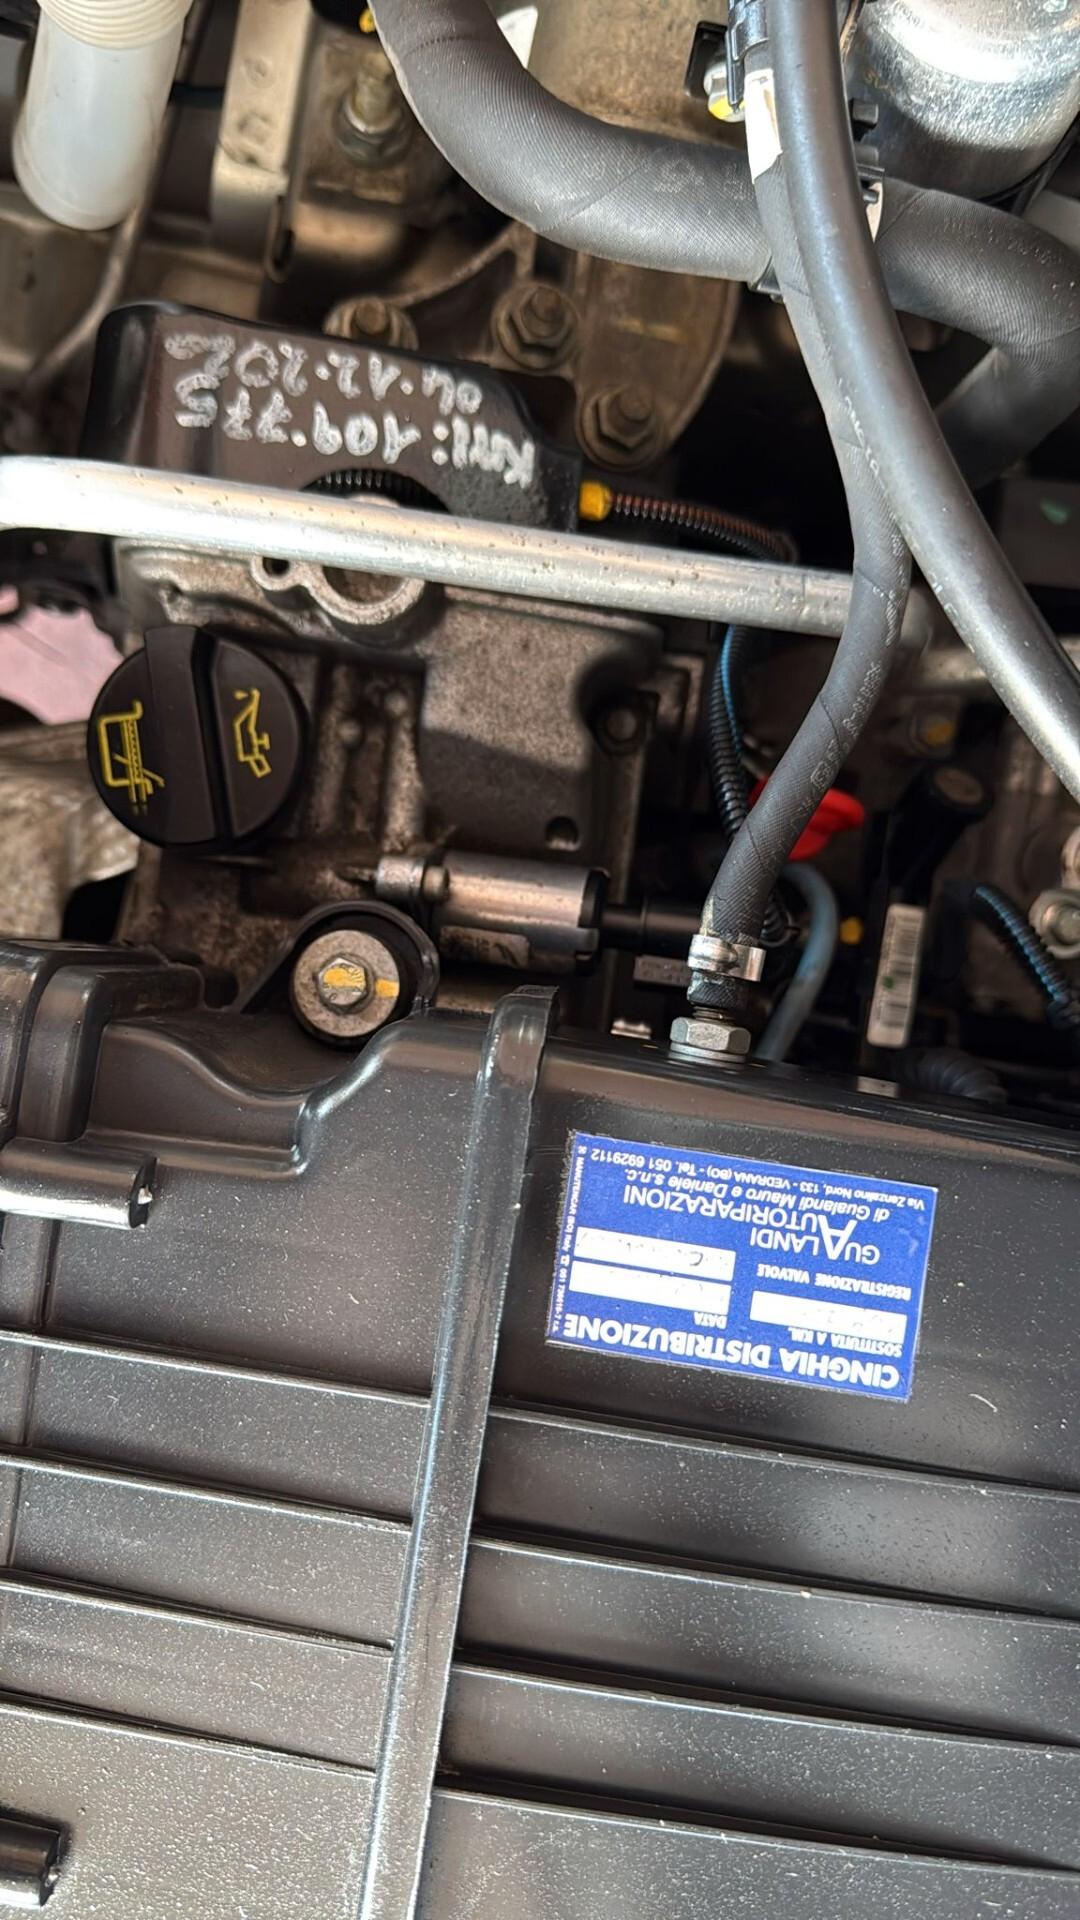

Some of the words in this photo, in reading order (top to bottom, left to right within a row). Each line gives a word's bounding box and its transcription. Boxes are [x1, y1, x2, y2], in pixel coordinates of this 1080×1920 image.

[590, 1148, 646, 1169] 6929112
[648, 1157, 673, 1173] 051
[624, 1168, 666, 1186] s.n.c.
[675, 1161, 697, 1177] Tel.
[706, 1165, 733, 1181] (BO)
[667, 1175, 729, 1199] Daniele
[733, 1171, 791, 1190] VEDRANA
[799, 1181, 819, 1195] 133
[730, 1185, 743, 1198] e
[745, 1188, 797, 1210] Mauro
[798, 1196, 871, 1221] Gualandi
[906, 1197, 925, 1211] Via
[872, 1207, 890, 1223] di
[749, 1227, 881, 1265] GUALANDI
[756, 1263, 810, 1284] VALVOLE
[814, 1272, 912, 1301] REGISTRAZIONE
[693, 1310, 728, 1330] DATA
[562, 1313, 772, 1369] DISTRIBUZIONE
[787, 1325, 815, 1344] KM.
[816, 1331, 828, 1346] A
[830, 1332, 903, 1358] SOSTITUITA
[778, 1347, 900, 1390] CINGHIA
